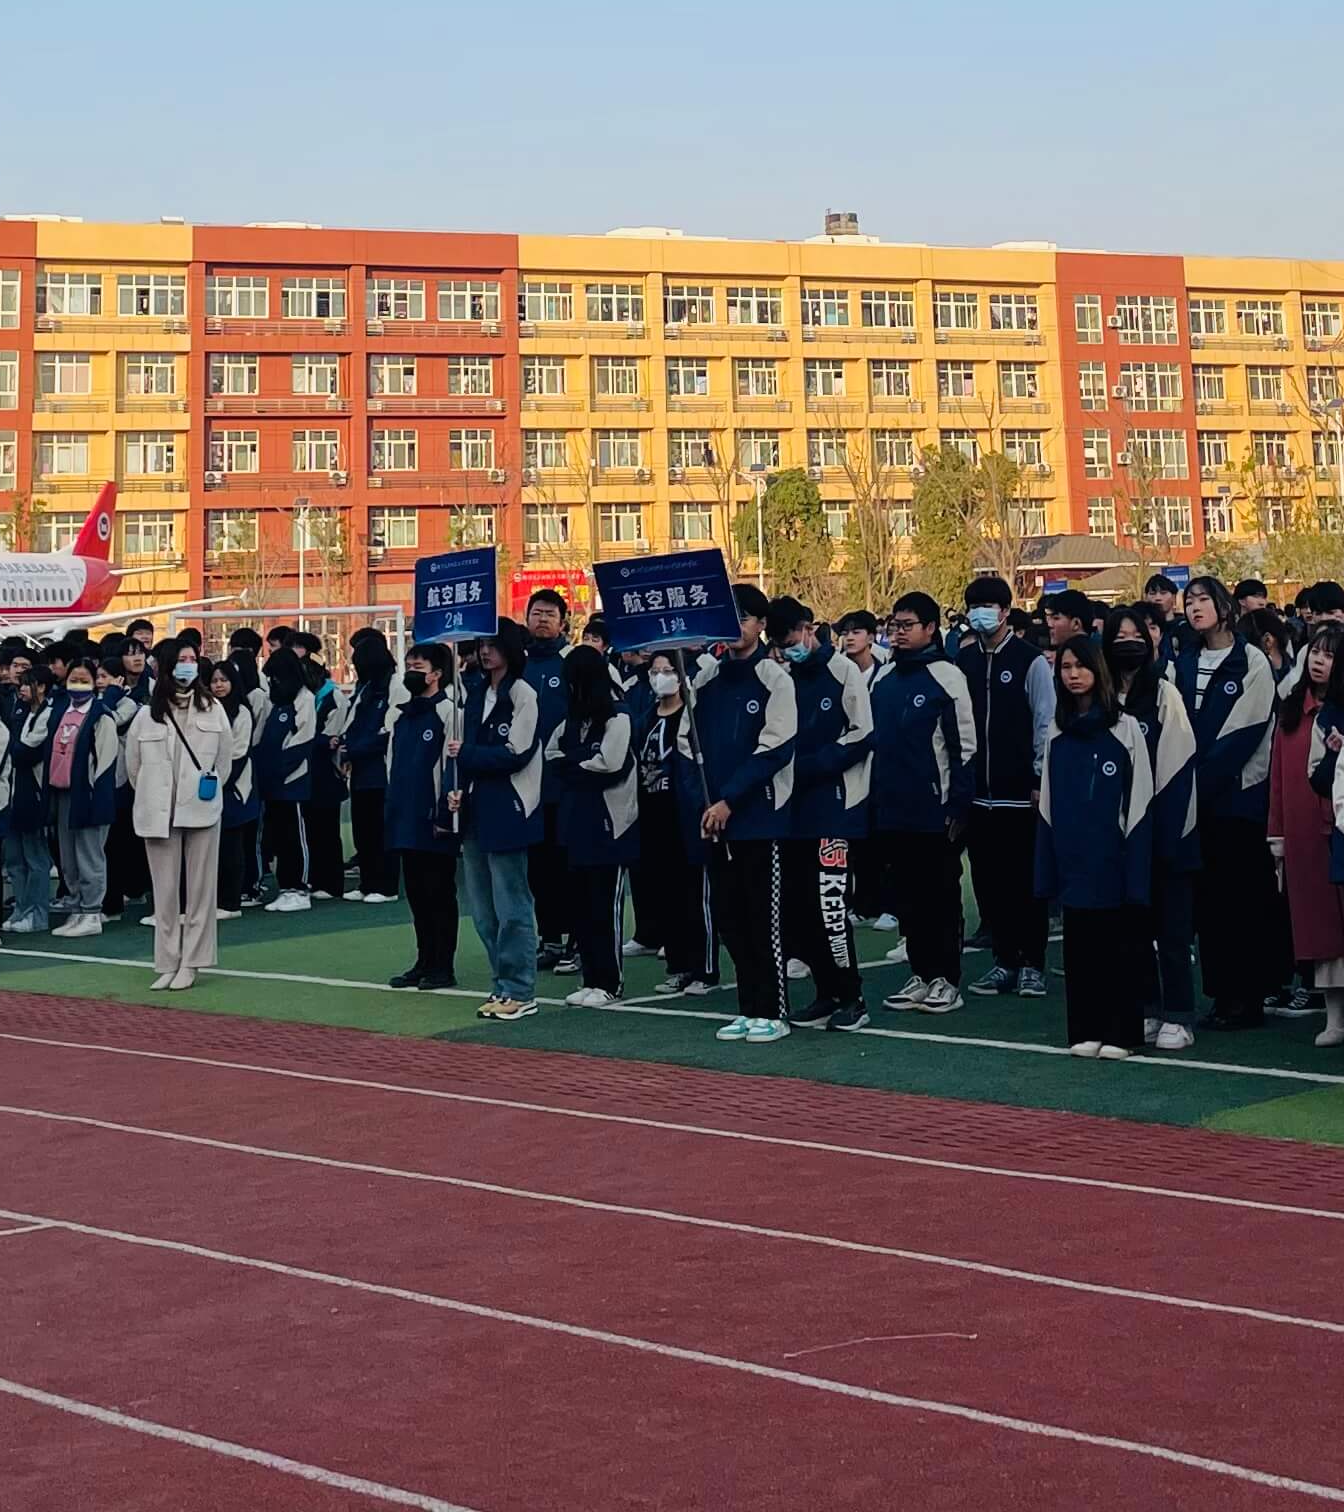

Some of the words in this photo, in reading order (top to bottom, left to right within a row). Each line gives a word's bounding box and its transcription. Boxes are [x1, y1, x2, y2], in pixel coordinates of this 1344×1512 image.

[427, 580, 482, 608] 航空服务
[622, 584, 709, 614] 航空服务
[444, 611, 463, 629] 2班
[658, 616, 687, 634] 1班
[819, 871, 848, 932] KEEP
